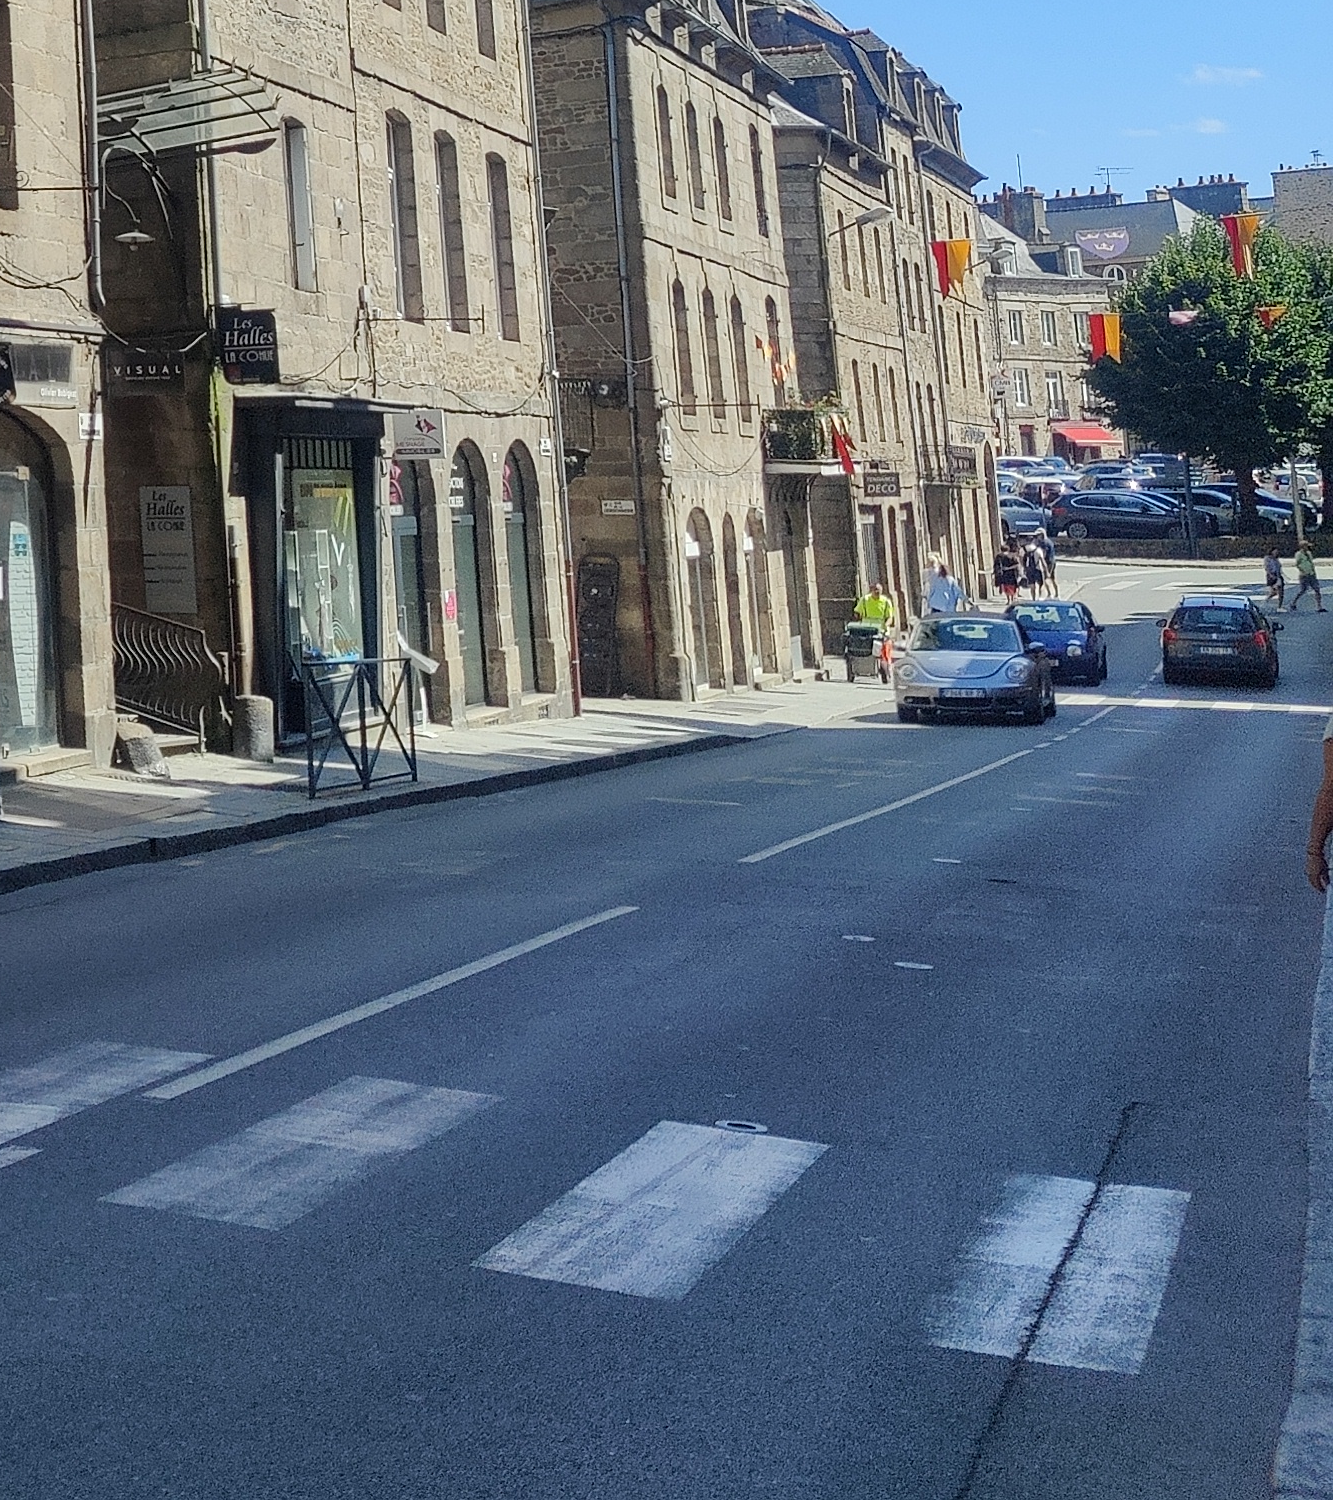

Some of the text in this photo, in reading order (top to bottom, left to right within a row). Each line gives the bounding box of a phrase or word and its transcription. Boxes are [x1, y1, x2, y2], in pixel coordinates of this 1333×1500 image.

[233, 318, 252, 329] Les
[224, 327, 274, 346] Halles
[225, 352, 236, 363] LA
[114, 365, 181, 376] VISUAL
[867, 484, 897, 493] DECO
[153, 491, 167, 501] Les
[146, 500, 185, 516] Halles
